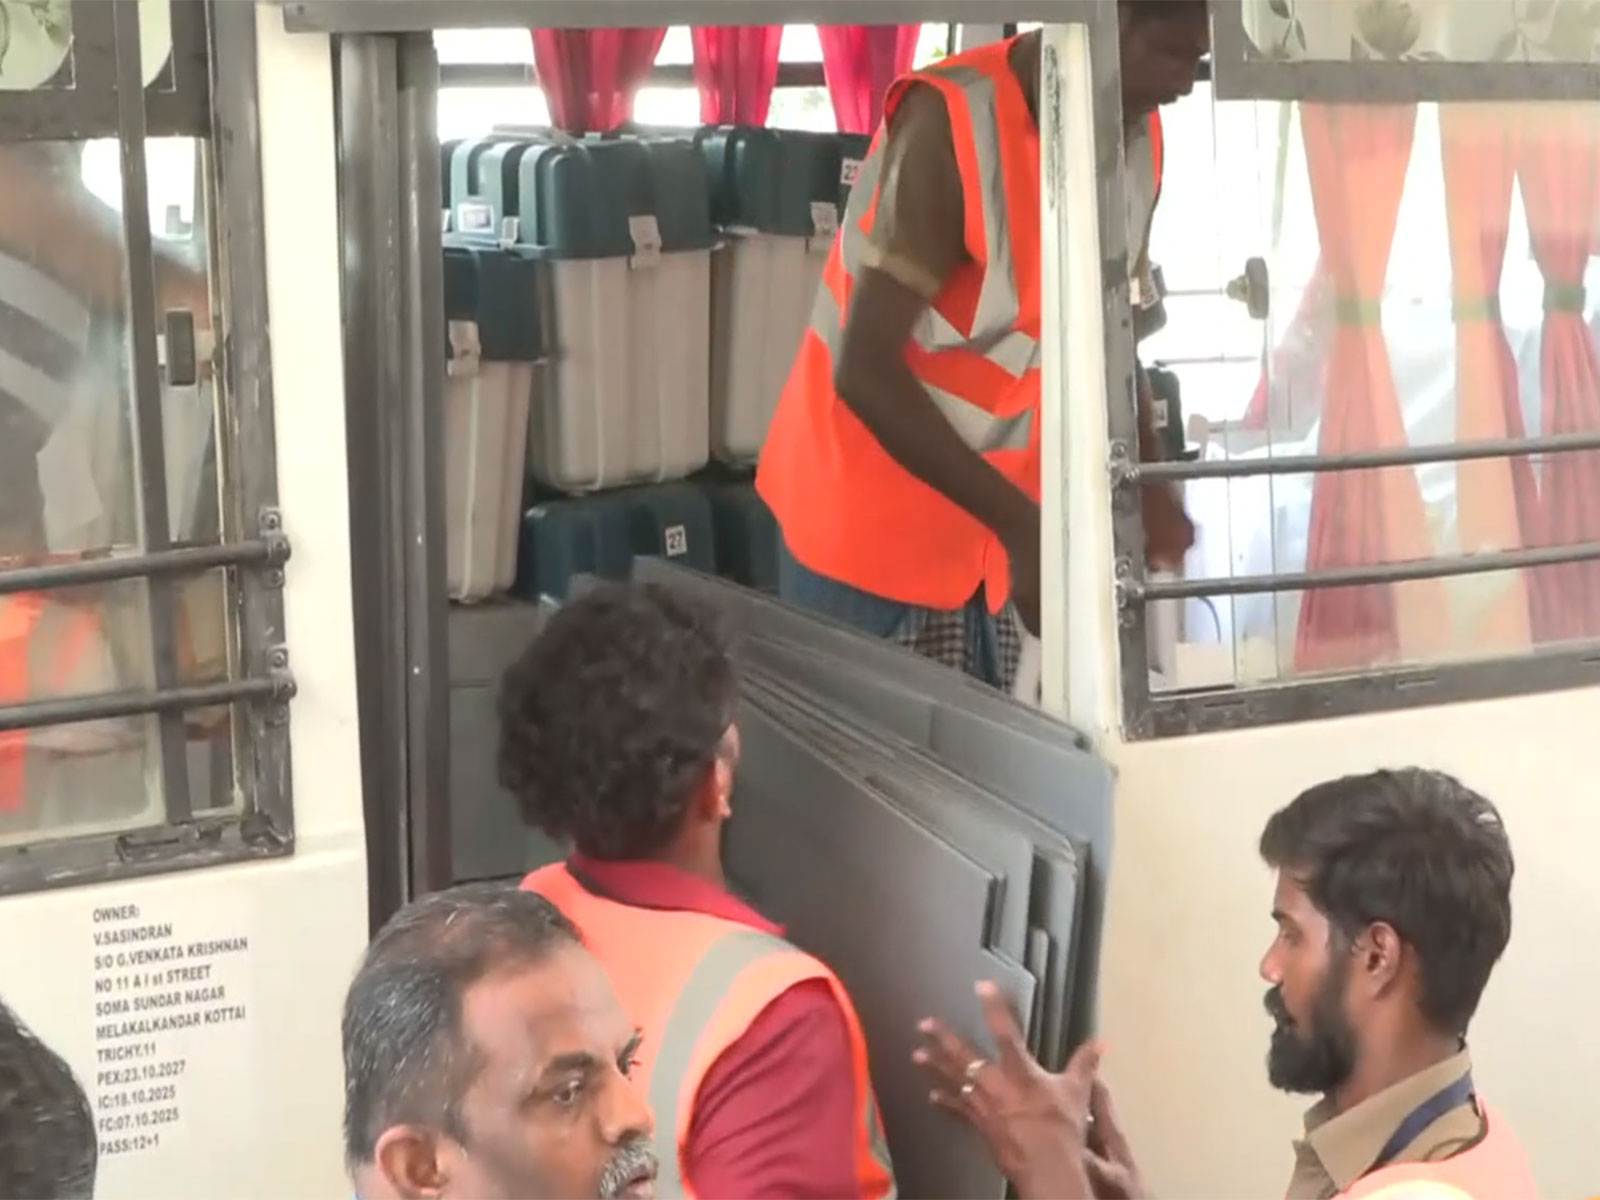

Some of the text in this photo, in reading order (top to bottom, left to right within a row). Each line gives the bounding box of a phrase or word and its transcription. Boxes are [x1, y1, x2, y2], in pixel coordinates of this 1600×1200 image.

[668, 531, 683, 549] 27
[93, 904, 140, 923] OWNER:
[93, 923, 173, 946] V.SASINDRAN
[117, 945, 184, 967] G.VENKATA
[187, 936, 248, 957] KRISHNAN
[95, 978, 112, 993] NO
[116, 975, 129, 990] 11
[133, 974, 142, 989] A
[166, 963, 212, 984] STREET
[96, 985, 225, 1017] SOMA SUNDAR NAGAR
[96, 1004, 246, 1041] MELAKALKANDAR KOTTAI
[97, 1042, 157, 1063] TRICHY.11
[97, 1059, 186, 1086] PEX:23.10.2027
[98, 1107, 180, 1132] FC:07.10.2025
